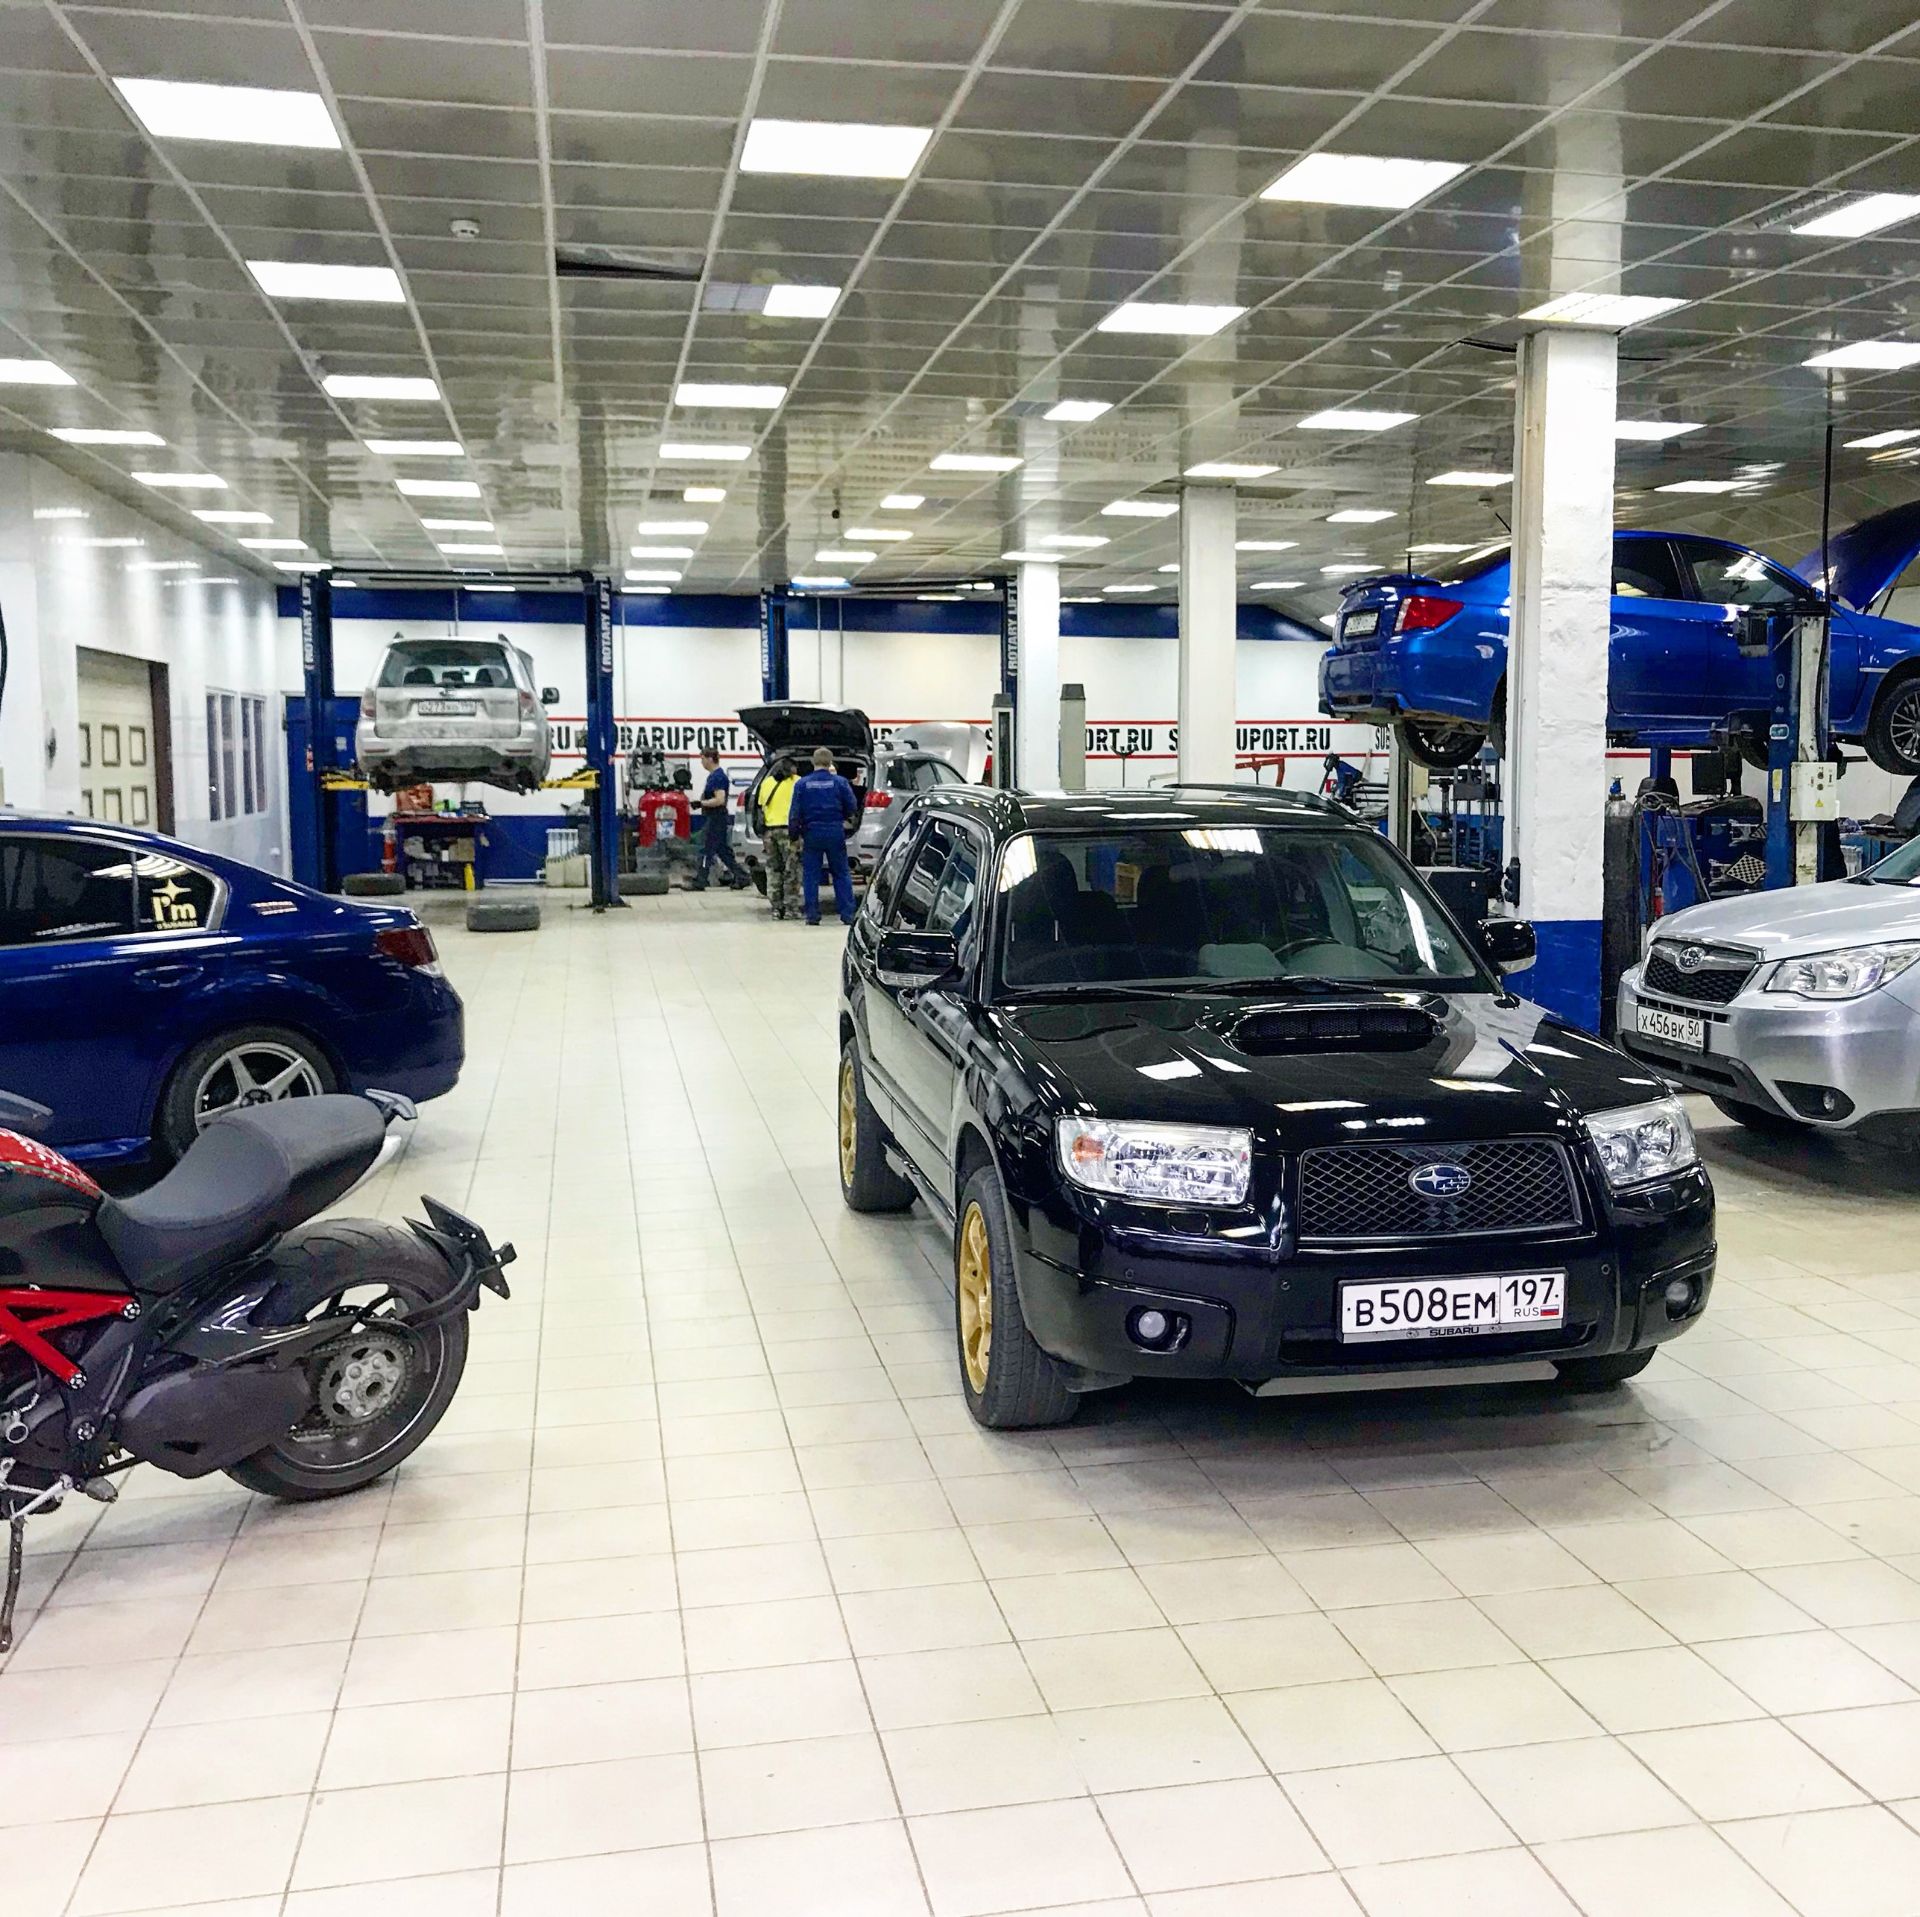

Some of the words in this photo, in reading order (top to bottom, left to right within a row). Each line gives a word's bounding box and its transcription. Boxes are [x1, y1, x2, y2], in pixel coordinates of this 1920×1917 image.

[600, 582, 611, 610] LIFT
[302, 607, 313, 663] ROTARY
[601, 612, 612, 665] ROTARY
[761, 622, 769, 672] ROTARY
[1007, 618, 1018, 670] ROTARY
[1236, 727, 1331, 751] UPORT.RU
[1505, 1277, 1555, 1307] 197
[1513, 1306, 1540, 1318] RUS
[1429, 1326, 1480, 1338] SUBARU
